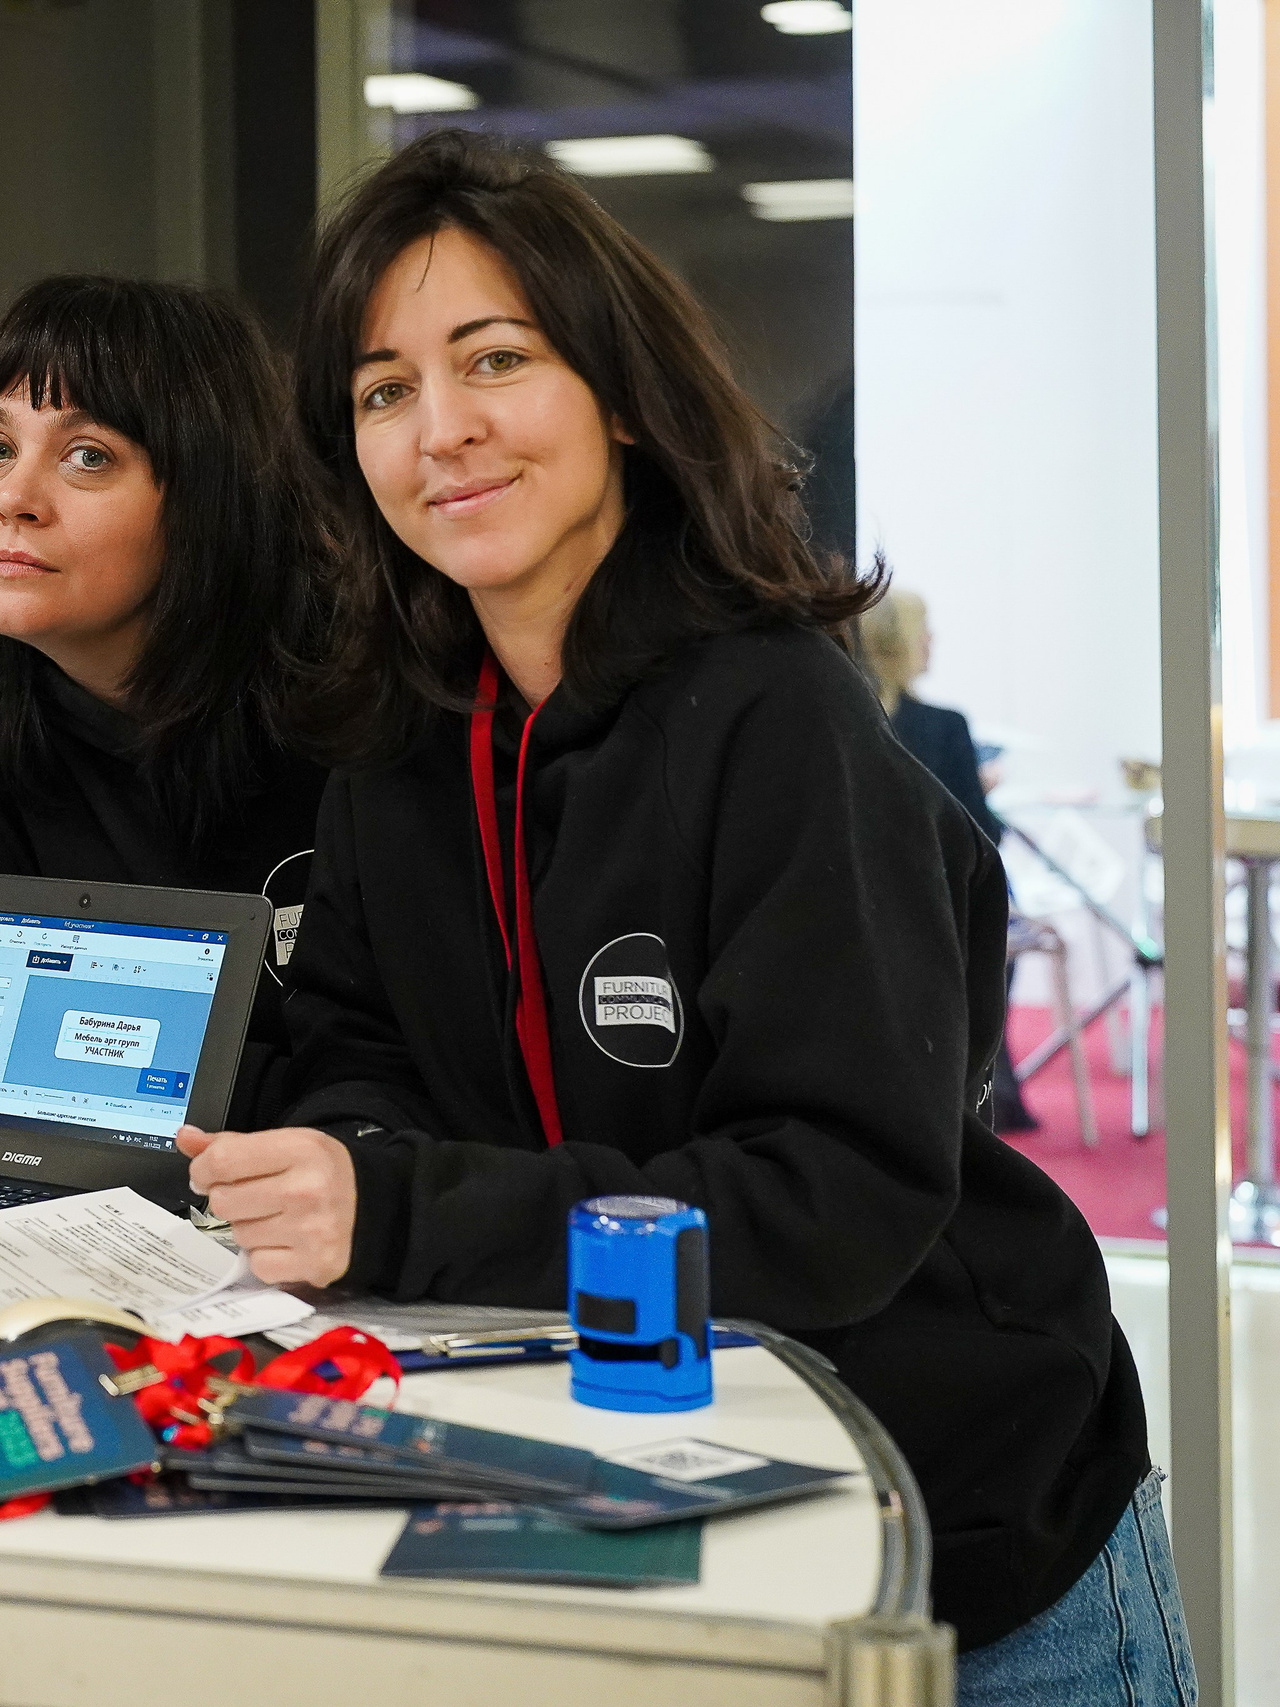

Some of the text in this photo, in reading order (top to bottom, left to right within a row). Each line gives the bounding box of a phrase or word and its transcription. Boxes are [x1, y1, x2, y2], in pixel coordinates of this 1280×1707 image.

[79, 1017, 141, 1032] Бабурина Дарья
[74, 1033, 140, 1048] Мебель арт групп
[84, 1046, 125, 1058] УЧАСТНИК
[147, 1074, 168, 1084] Печать
[1, 1151, 43, 1166] DIGMA
